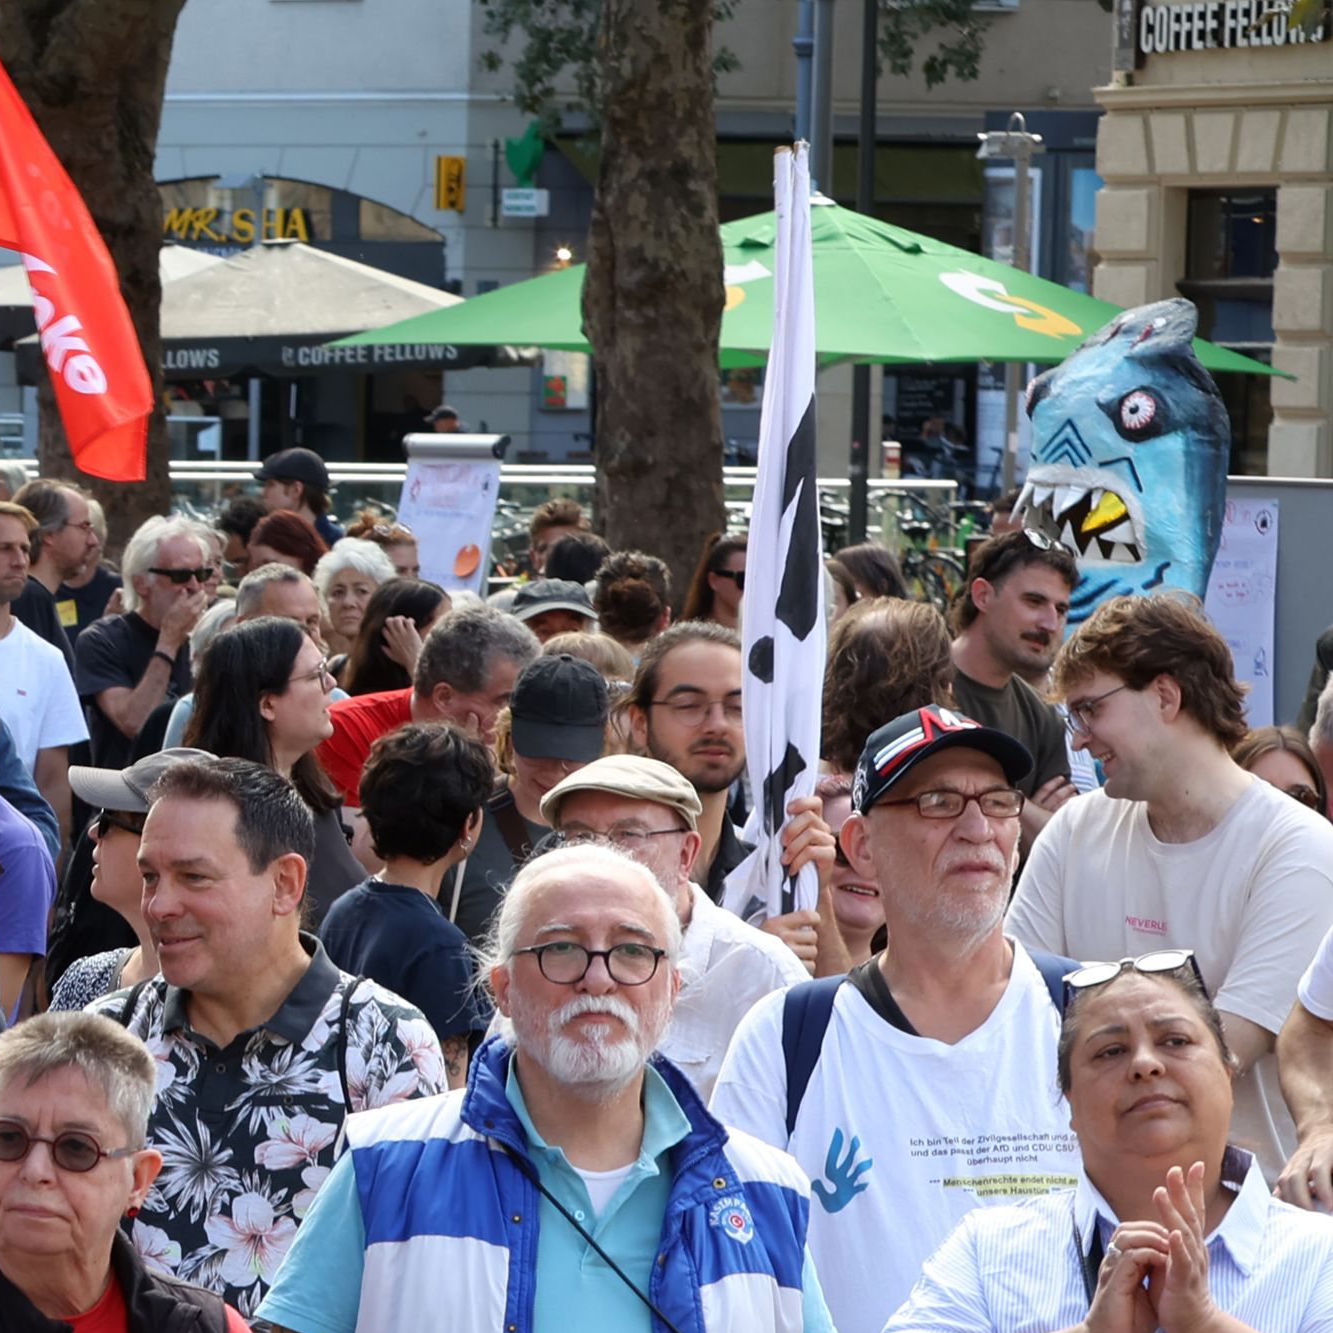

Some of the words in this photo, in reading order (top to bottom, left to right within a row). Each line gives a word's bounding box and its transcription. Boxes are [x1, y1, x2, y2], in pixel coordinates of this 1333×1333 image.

[1141, 3, 1219, 54] COFFEE
[298, 345, 368, 366] COFFEE
[373, 342, 458, 362] FELLOWS
[910, 1138, 925, 1146] Ich
[927, 1138, 942, 1146] bin
[944, 1137, 960, 1146] Teil
[961, 1137, 975, 1145] der
[1051, 1133, 1067, 1142] und
[911, 1149, 929, 1157] und
[931, 1148, 948, 1156] das
[976, 1146, 990, 1155] der
[993, 1144, 1010, 1153] AfD
[1013, 1143, 1030, 1152] und
[1055, 1143, 1075, 1152] CSU
[966, 1155, 1013, 1167] überhaupt
[1015, 1154, 1038, 1163] nicht
[943, 1177, 1018, 1187] Menschenrechte
[1020, 1176, 1044, 1185] endet
[1045, 1176, 1067, 1185] nicht
[976, 1187, 1008, 1196] unsere
